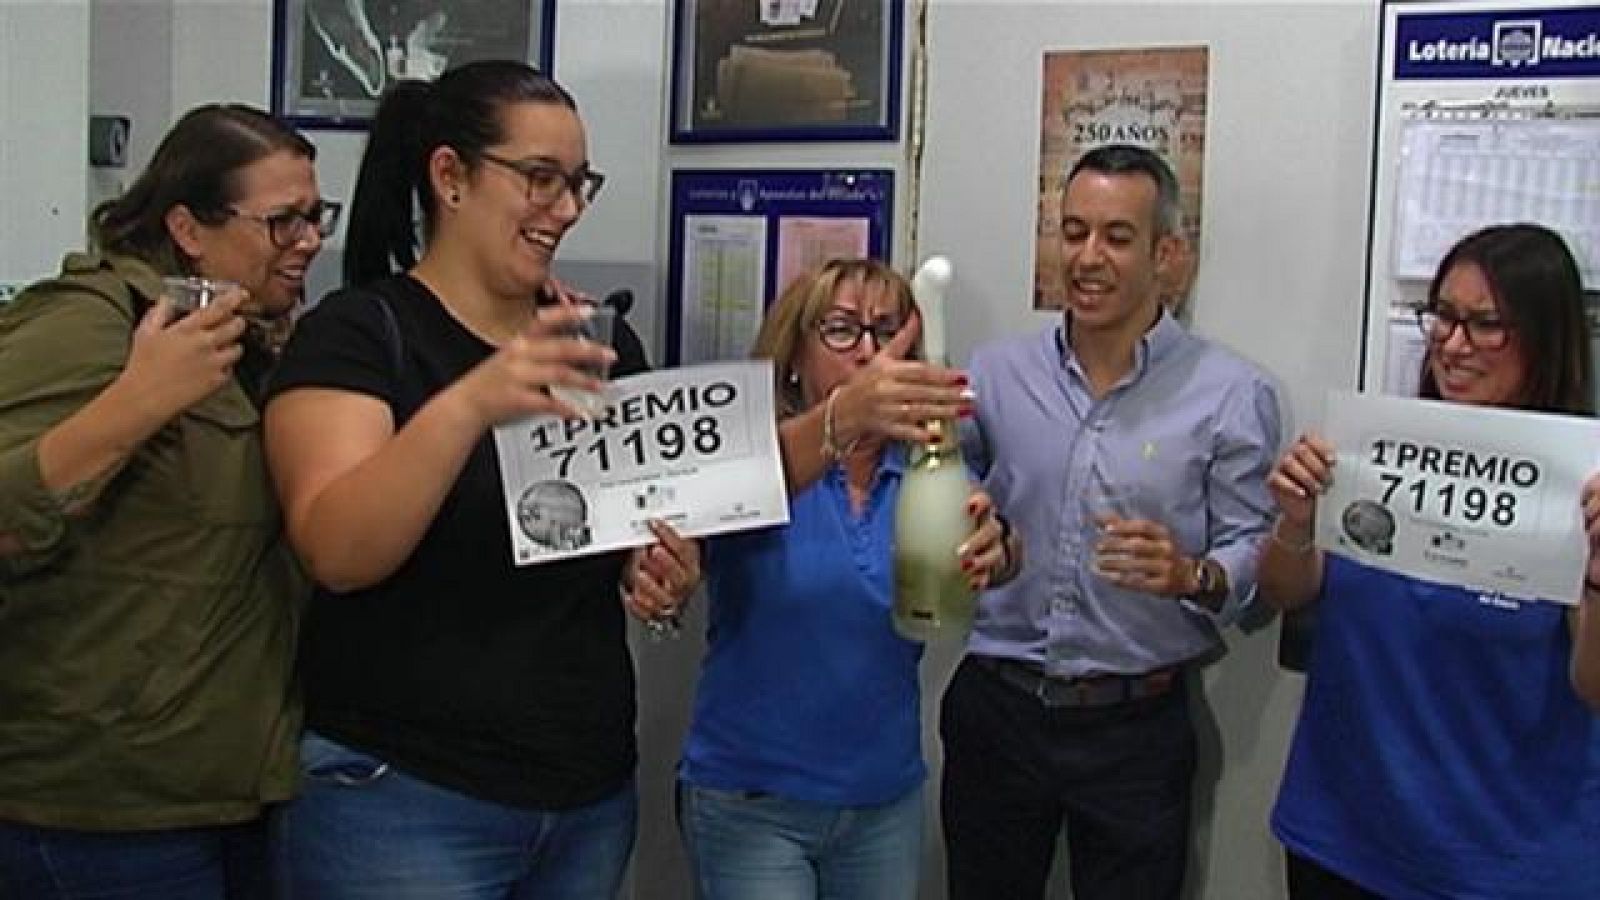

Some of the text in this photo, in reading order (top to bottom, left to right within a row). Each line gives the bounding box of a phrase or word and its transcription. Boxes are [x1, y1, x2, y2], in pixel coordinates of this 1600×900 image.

[1409, 38, 1489, 61] Lotería
[1073, 123, 1113, 144] 250
[549, 415, 722, 478] 71198
[1378, 473, 1517, 527] 71198
